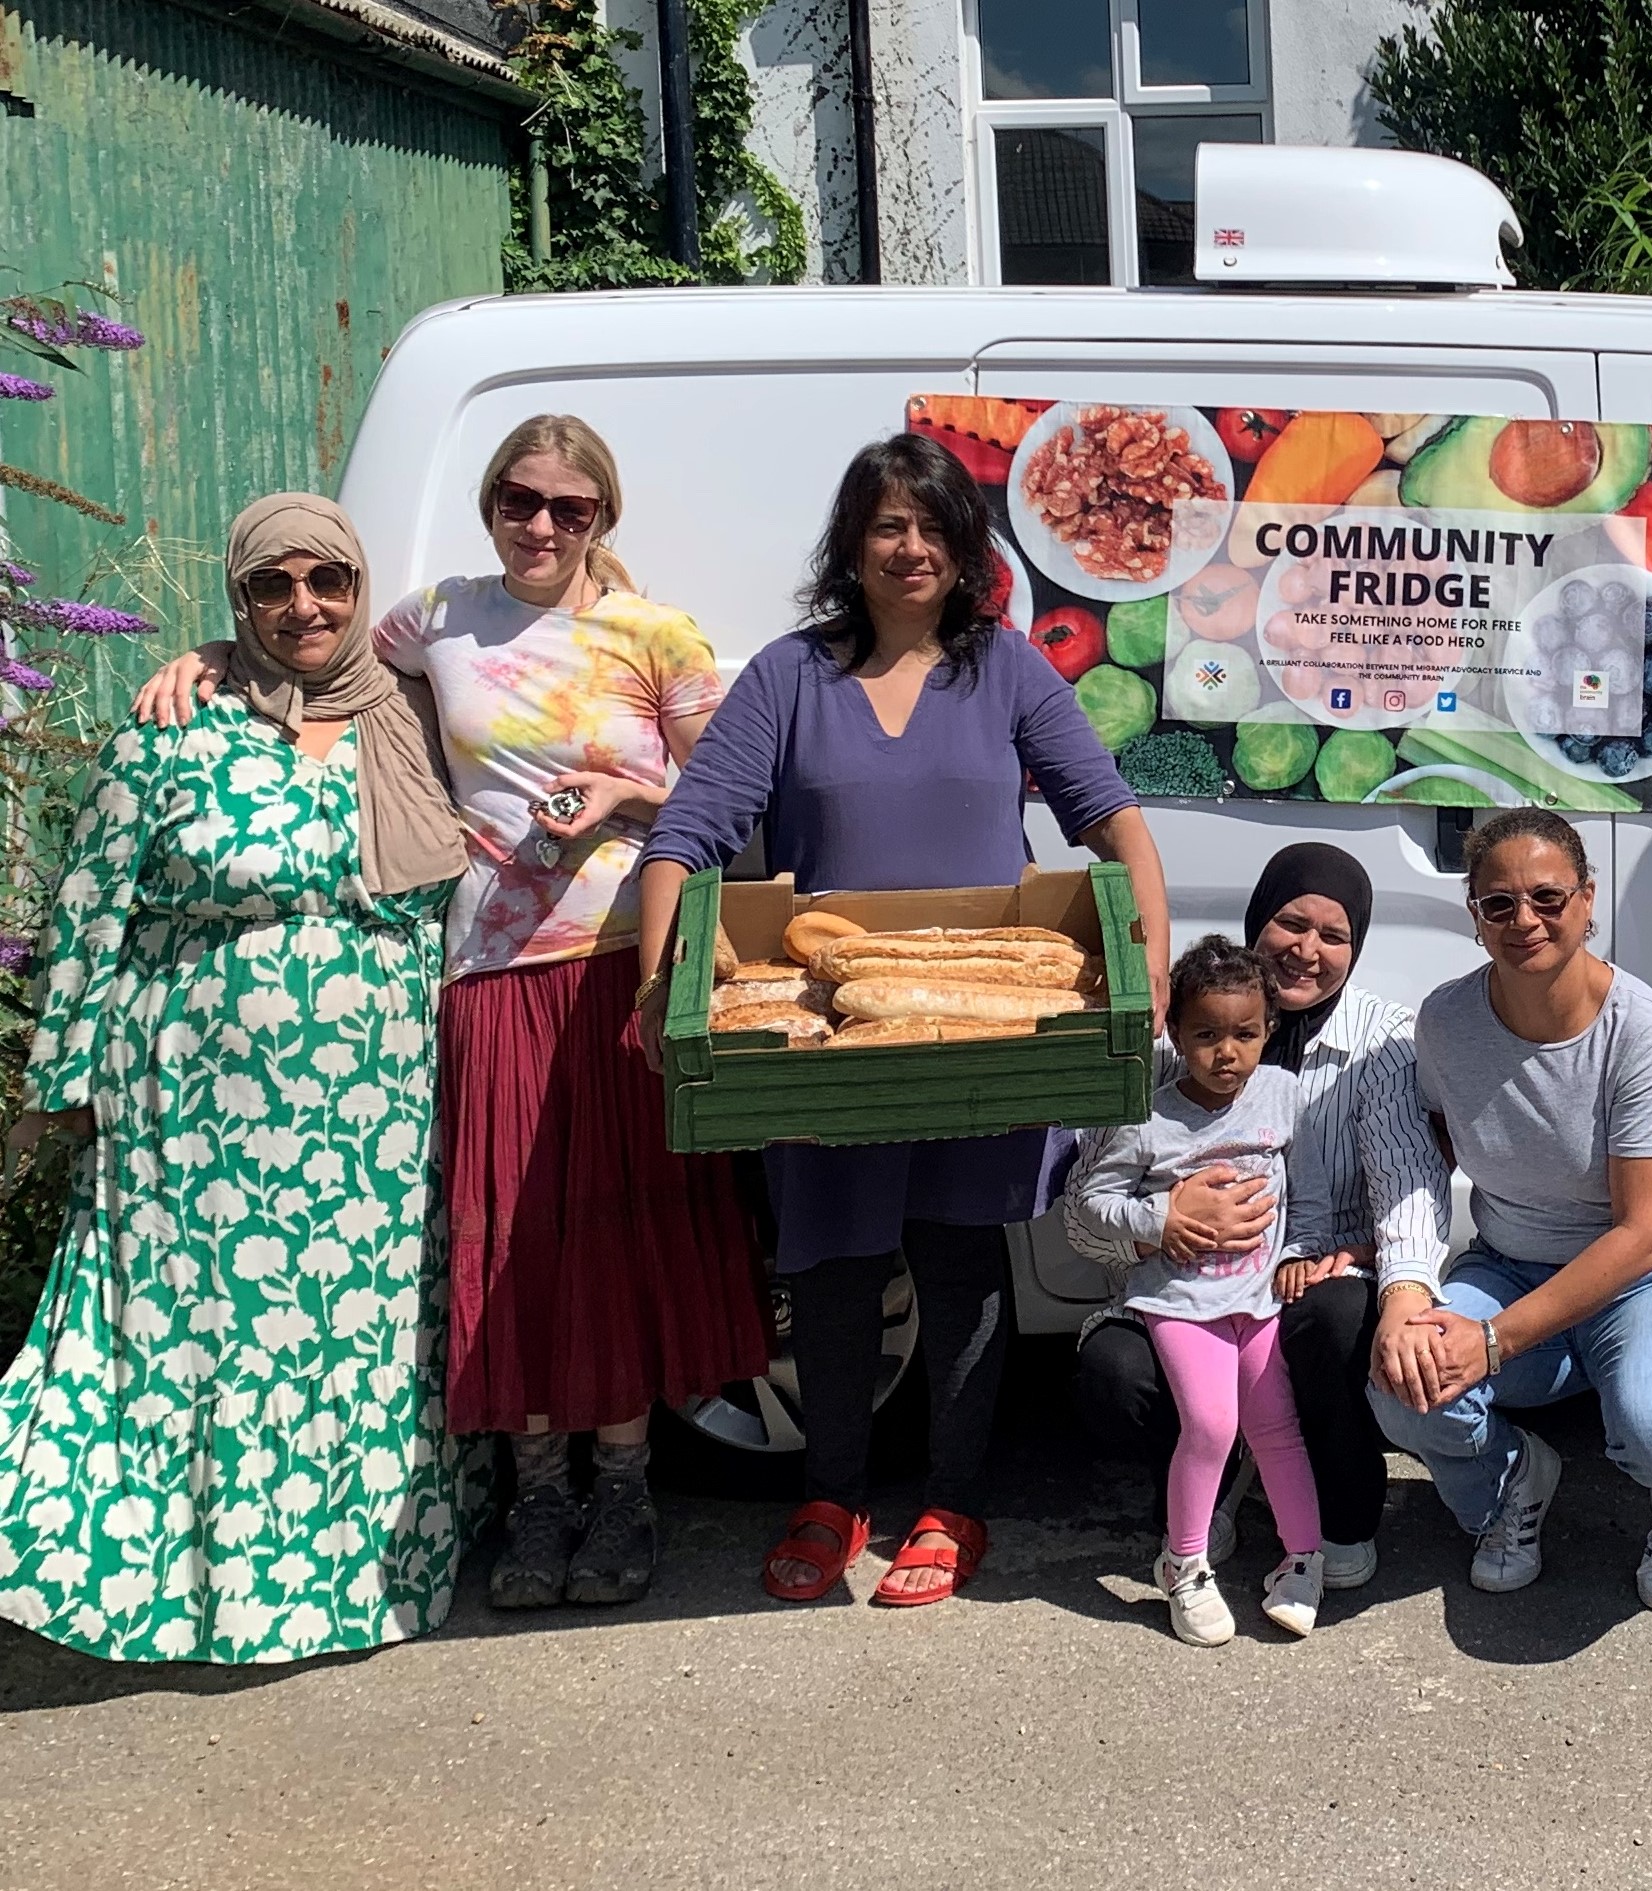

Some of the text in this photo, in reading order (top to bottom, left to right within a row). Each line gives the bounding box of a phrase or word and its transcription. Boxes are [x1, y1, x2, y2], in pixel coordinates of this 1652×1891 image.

[1255, 522, 1554, 567] COMMUNITY
[1329, 570, 1490, 609] FRIDGE
[1294, 613, 1522, 632] TAKE SOMETHING HOME FOR FREE
[1330, 632, 1485, 648] FEEL LIKE A FOOD HERO
[1303, 661, 1364, 670] COLLABORATION
[1366, 663, 1400, 671] BETWEEN
[1401, 664, 1414, 672] THE
[1416, 665, 1450, 673] MIGRANT
[1451, 666, 1492, 674] ADVOCACY
[1494, 667, 1524, 676] SERVICE
[1525, 668, 1542, 677] AND
[1358, 672, 1444, 682] THE COMMUNITY BRAIN
